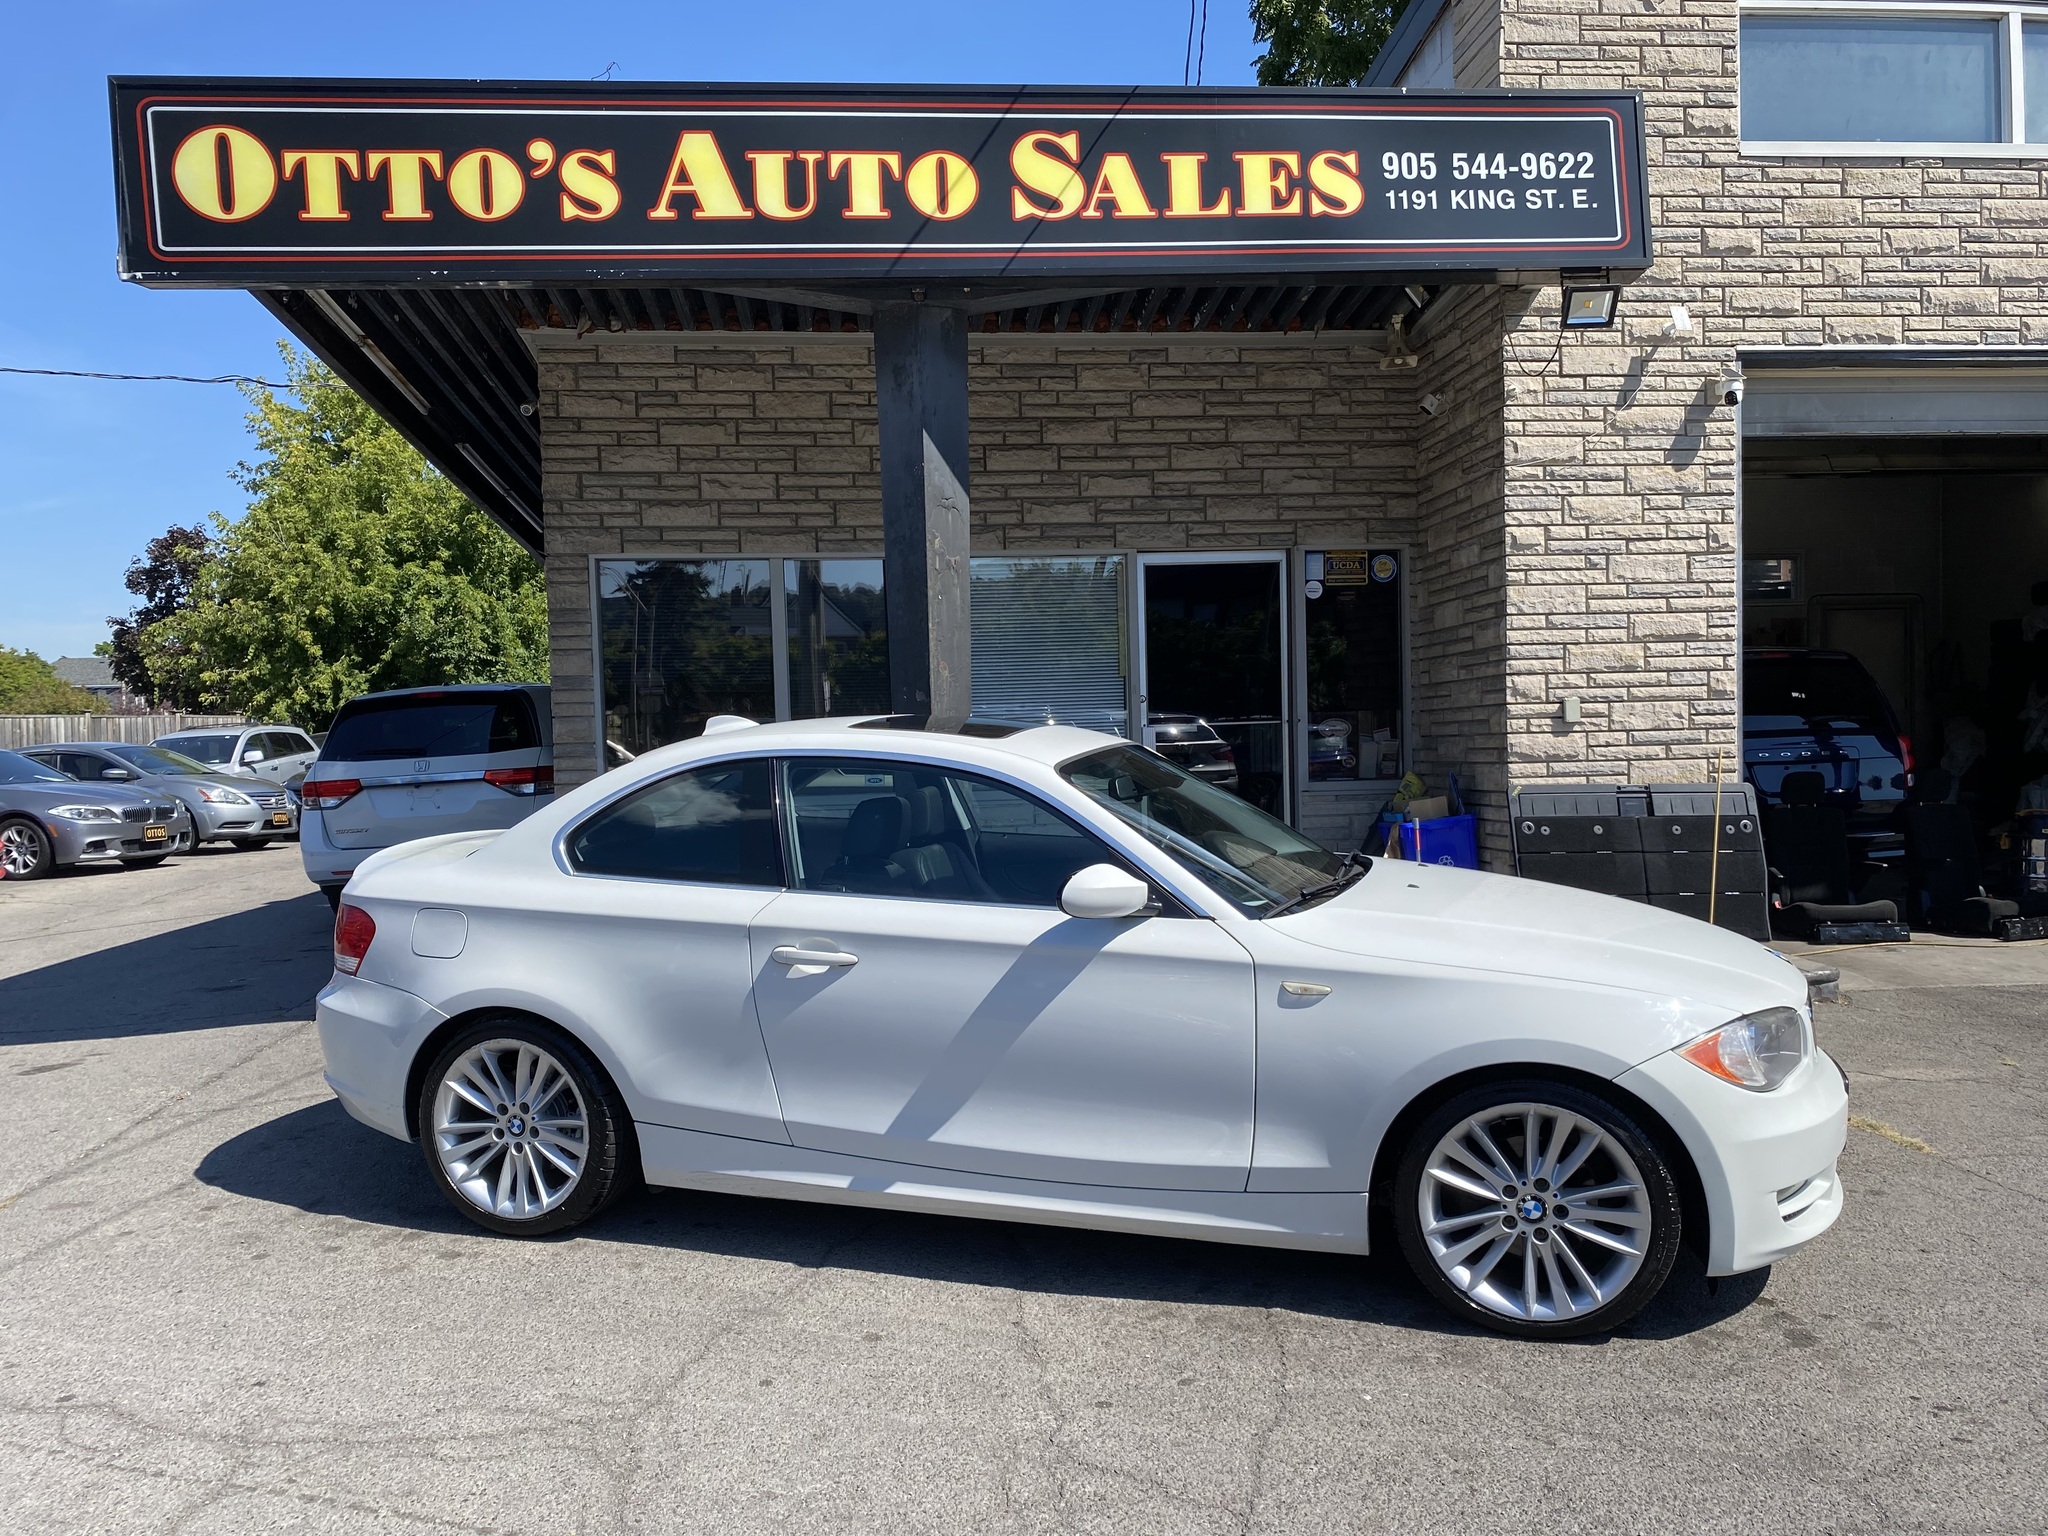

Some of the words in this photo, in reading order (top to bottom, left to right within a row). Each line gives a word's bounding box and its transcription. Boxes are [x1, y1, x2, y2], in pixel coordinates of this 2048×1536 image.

[171, 123, 622, 223] OTTO'S
[646, 129, 980, 222] AUTO
[1010, 129, 1366, 222] SALES
[1381, 151, 1437, 180] 905
[1452, 151, 1595, 180] 544-9622
[1385, 189, 1438, 210] 1191
[1450, 188, 1516, 210] KING
[1525, 188, 1565, 210] ST.
[1572, 188, 1598, 209] E.
[1332, 561, 1361, 569] UCDA
[146, 827, 166, 838] OTTOS
